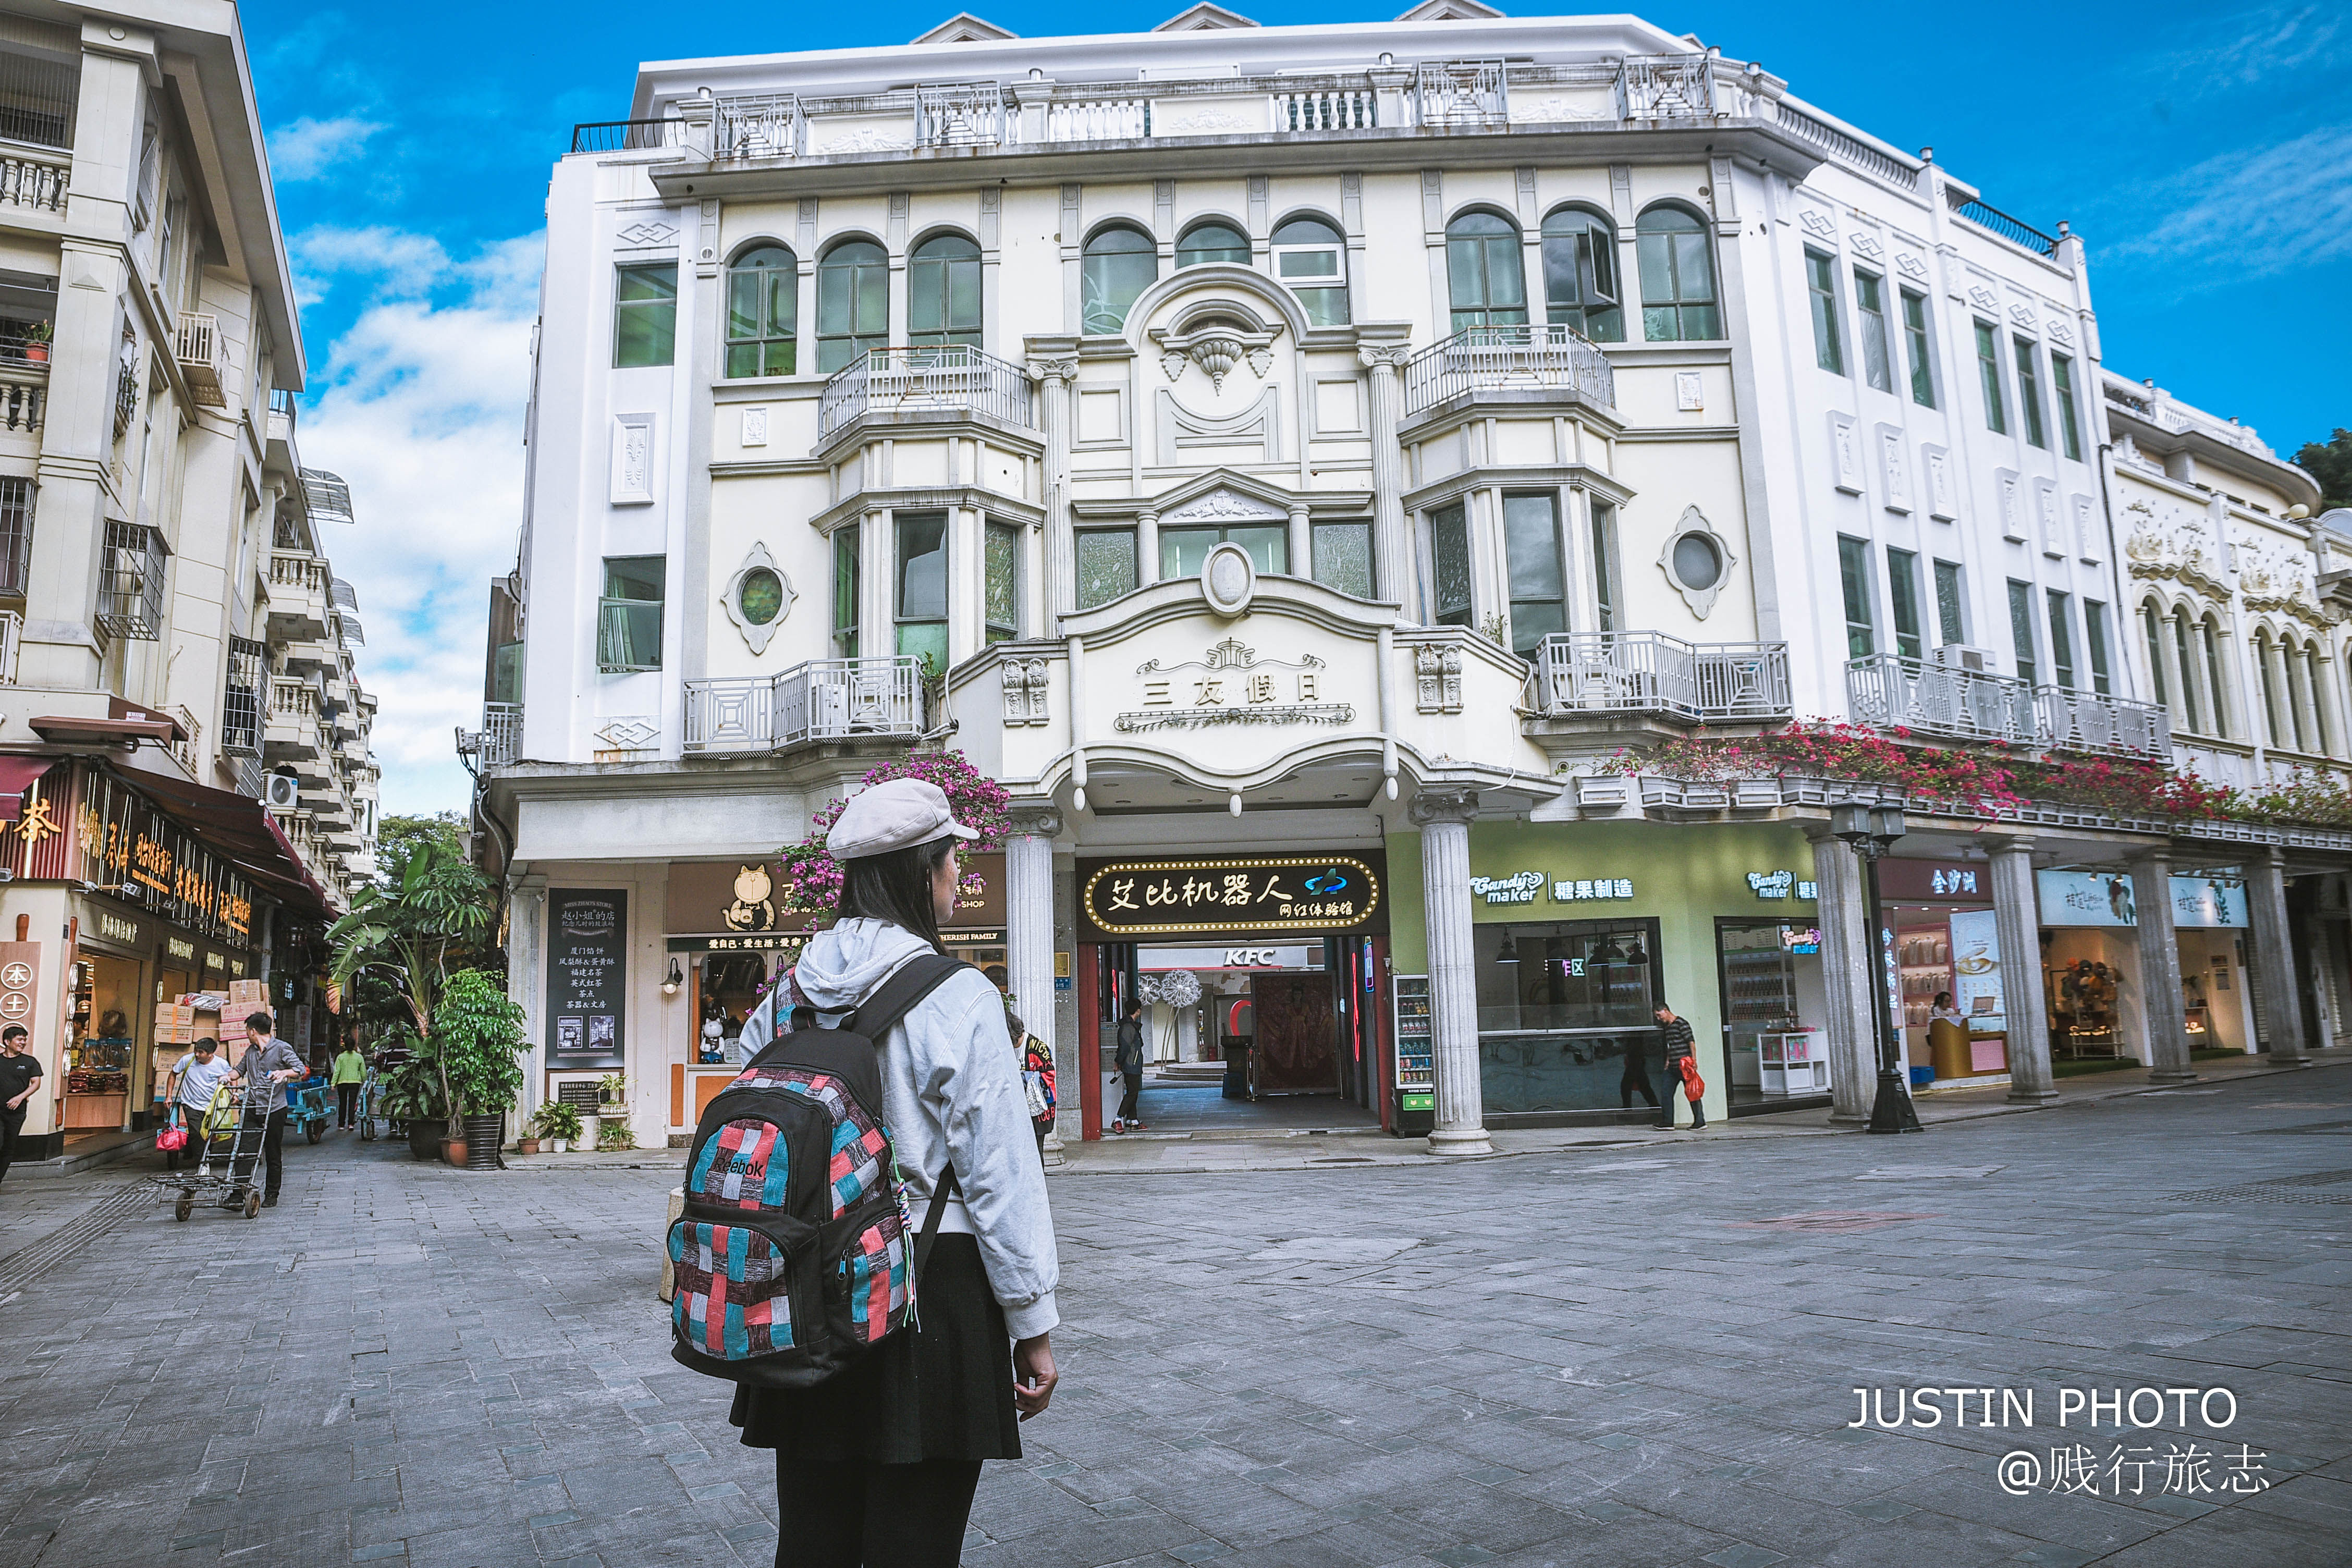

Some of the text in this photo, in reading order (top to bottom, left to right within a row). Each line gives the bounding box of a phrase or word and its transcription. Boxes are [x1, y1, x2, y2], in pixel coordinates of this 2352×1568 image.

[1144, 674, 1320, 706] 三友假日
[13, 798, 62, 842] 茶
[1470, 872, 1530, 895] Candy
[1748, 871, 1784, 890] Candy
[1107, 874, 1293, 911] 艾比机器人
[1487, 889, 1537, 903] maker
[1553, 879, 1634, 900] 糖果制造
[1759, 887, 1789, 898] maker
[1279, 901, 1353, 917] 网红体验馆
[1782, 929, 1815, 946] Candy
[1224, 949, 1276, 965] KFC
[1793, 943, 1819, 954] maker
[570, 968, 603, 976] 福建名茶
[570, 979, 603, 987] 英式红茶
[713, 1158, 764, 1178] Reebok
